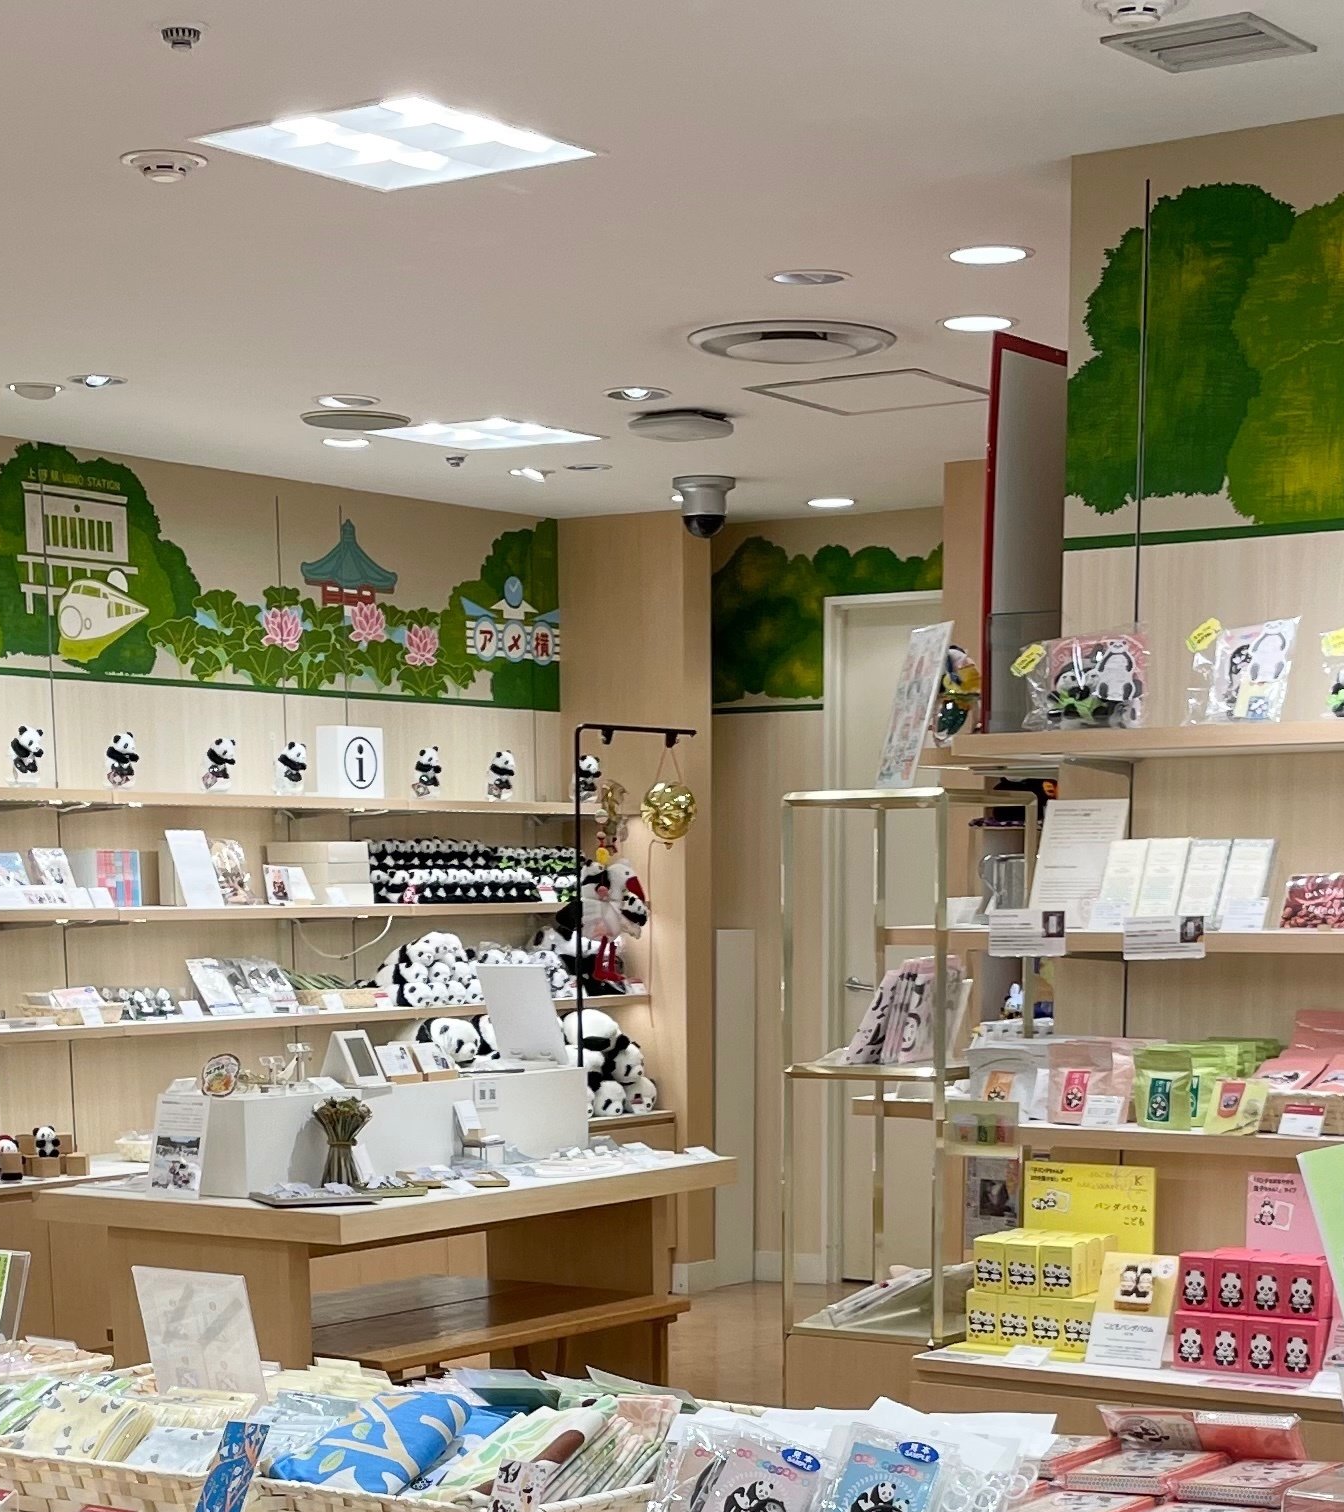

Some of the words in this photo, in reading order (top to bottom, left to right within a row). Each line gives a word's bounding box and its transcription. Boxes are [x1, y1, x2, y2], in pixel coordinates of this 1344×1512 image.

[87, 476, 121, 491] STATION
[479, 629, 550, 657] アメ横
